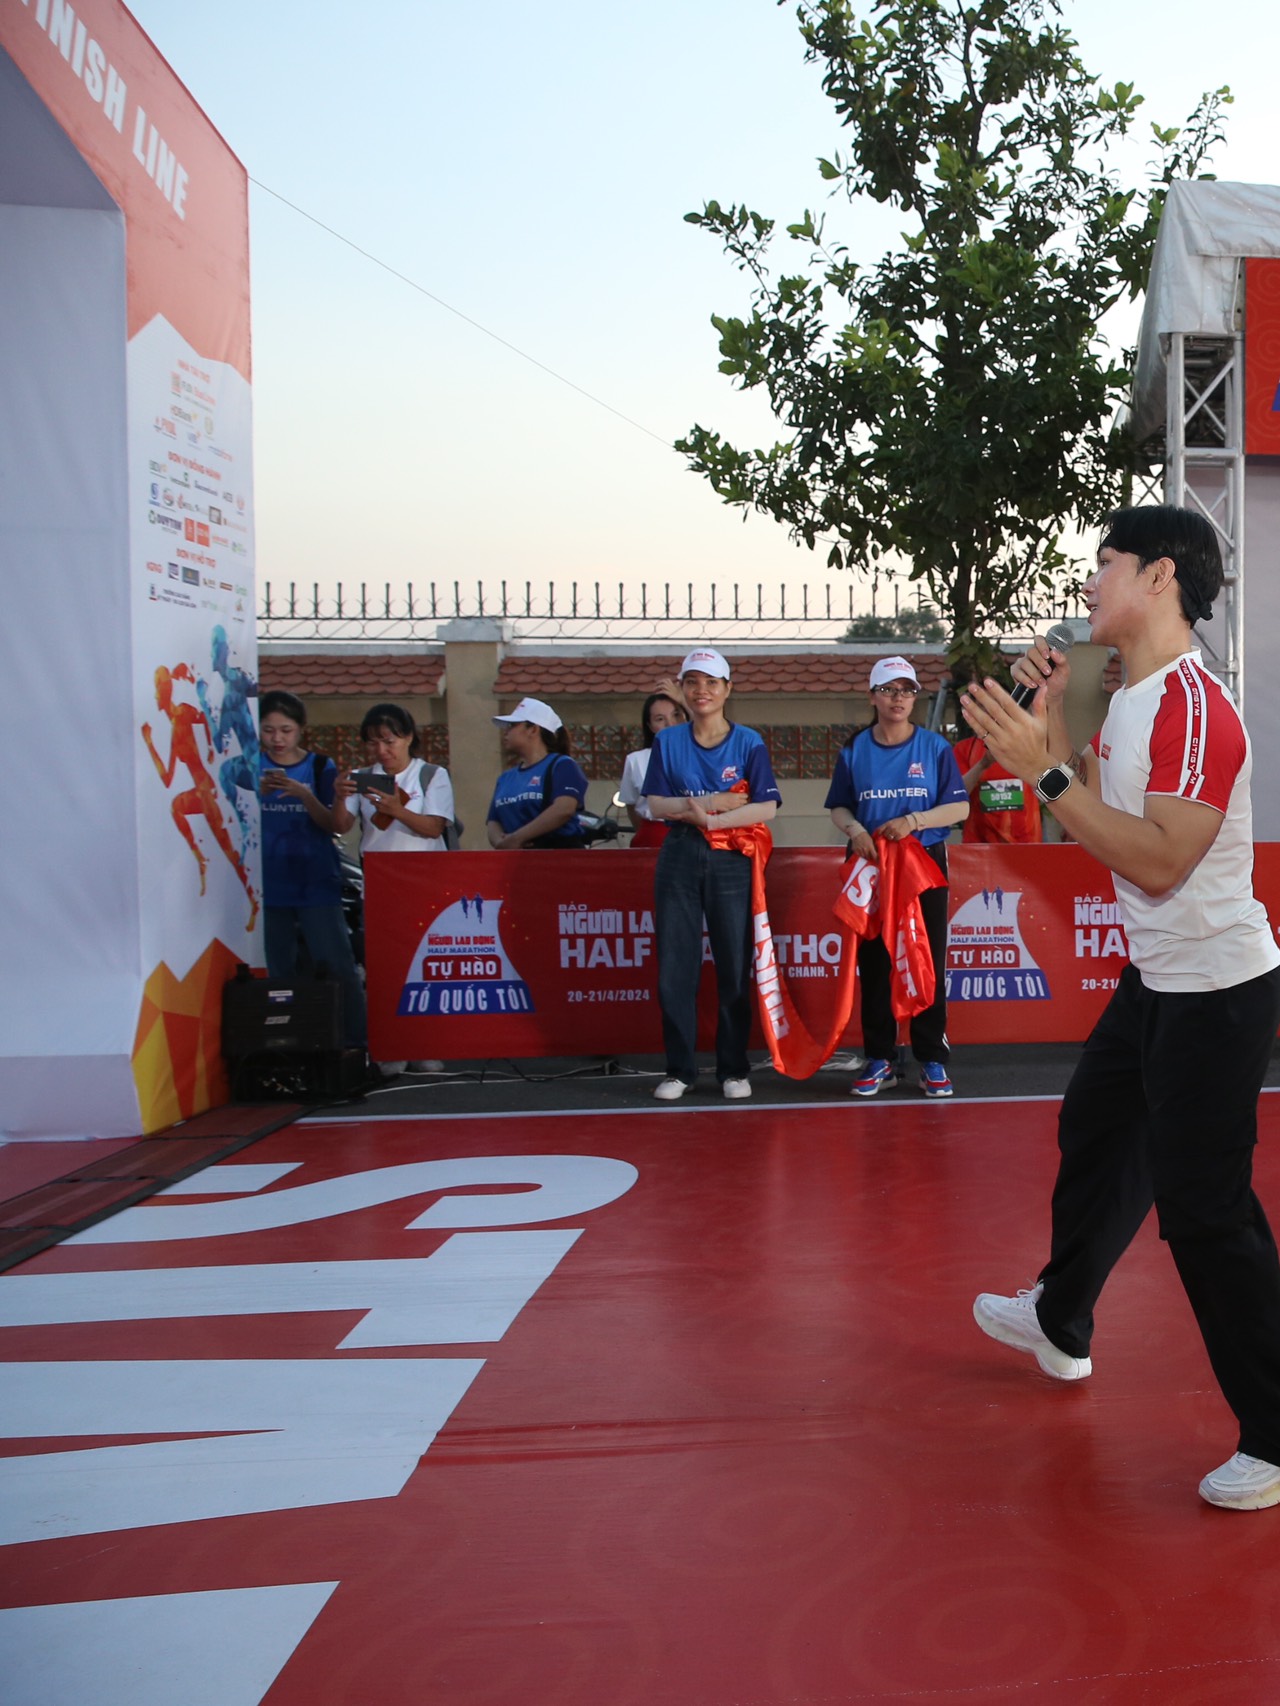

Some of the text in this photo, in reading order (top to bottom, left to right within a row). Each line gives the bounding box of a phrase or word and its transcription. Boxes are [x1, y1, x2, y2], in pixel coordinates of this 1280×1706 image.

[21, 0, 189, 222] INISH LINE
[629, 910, 655, 934] LA
[1074, 902, 1124, 926] NGƯ
[560, 938, 651, 968] HALF
[1075, 928, 1127, 958] HA
[428, 956, 497, 979] TỰ HÀO
[950, 945, 1015, 967] TỰ HÀO
[567, 989, 650, 1002] 20-21/4/2024
[961, 971, 1006, 1000] QUỐC
[1082, 978, 1120, 990] 20-21/
[440, 984, 487, 1013] QUỐC
